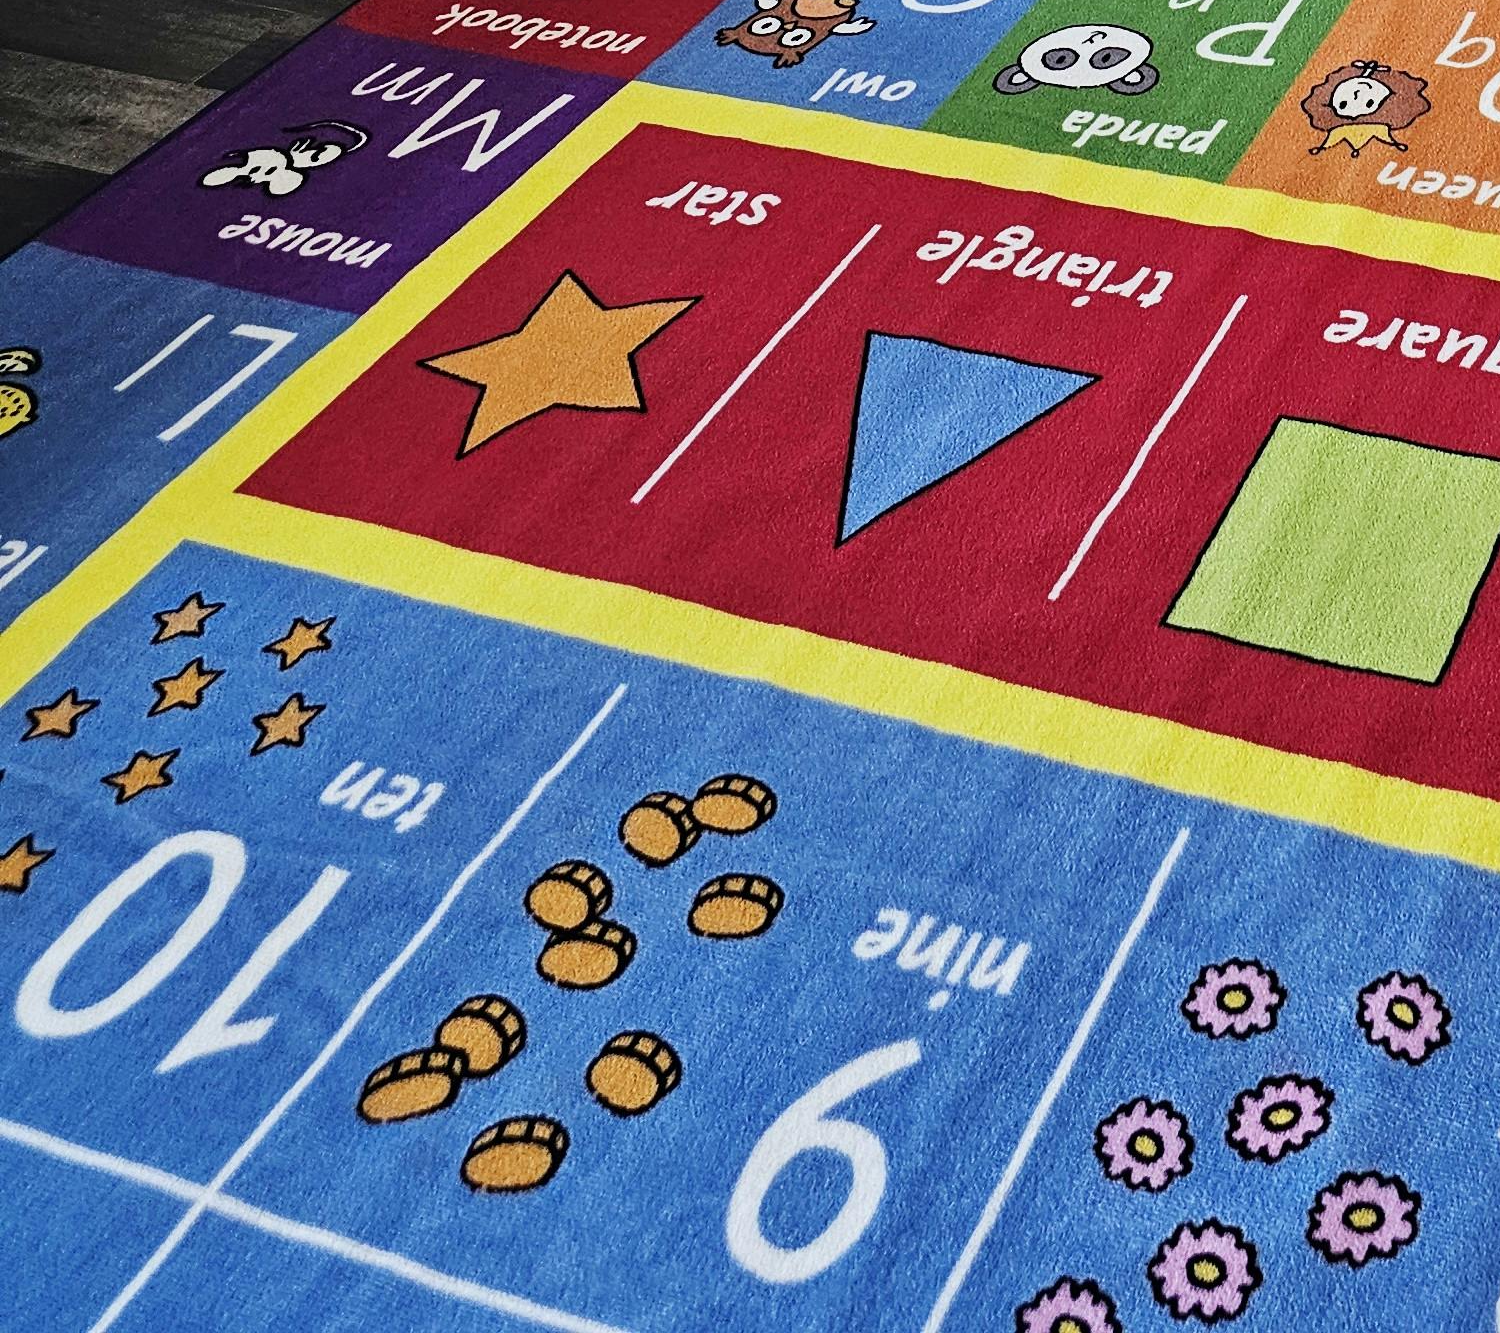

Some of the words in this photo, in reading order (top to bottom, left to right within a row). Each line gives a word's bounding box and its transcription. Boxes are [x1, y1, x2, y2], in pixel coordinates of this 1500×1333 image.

[433, 4, 645, 53] notebook
[810, 68, 916, 102] owl
[1062, 110, 1228, 155] panda
[646, 182, 780, 225] star
[219, 215, 392, 268] mouse
[917, 226, 1172, 308] triangle
[321, 762, 444, 832] ten
[13, 830, 351, 1075] 10
[853, 909, 1030, 1009] nine
[727, 1039, 920, 1283] 9
